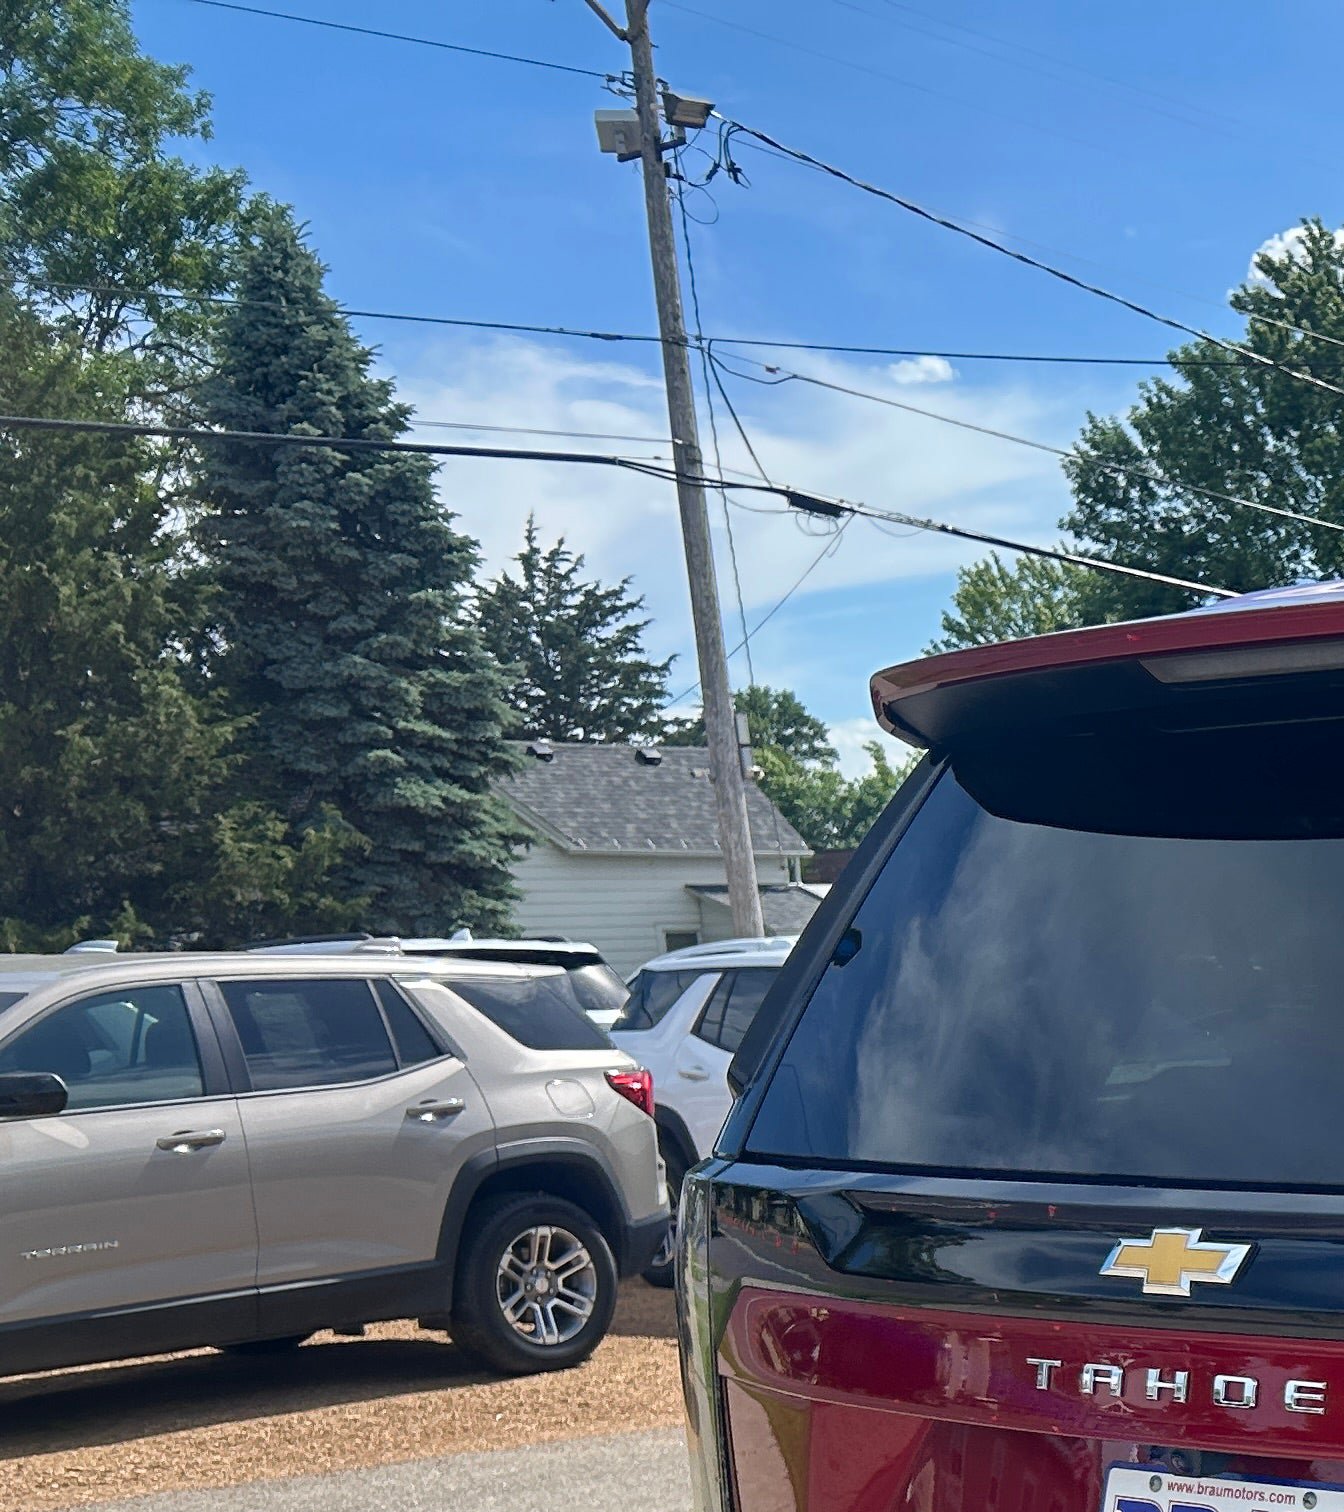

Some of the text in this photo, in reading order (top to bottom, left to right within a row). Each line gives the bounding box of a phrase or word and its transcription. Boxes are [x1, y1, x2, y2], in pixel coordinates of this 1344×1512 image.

[20, 1240, 119, 1260] TERRAIN
[1025, 1357, 1329, 1415] TAHOE
[1166, 1480, 1296, 1505] www.braumotors.com
